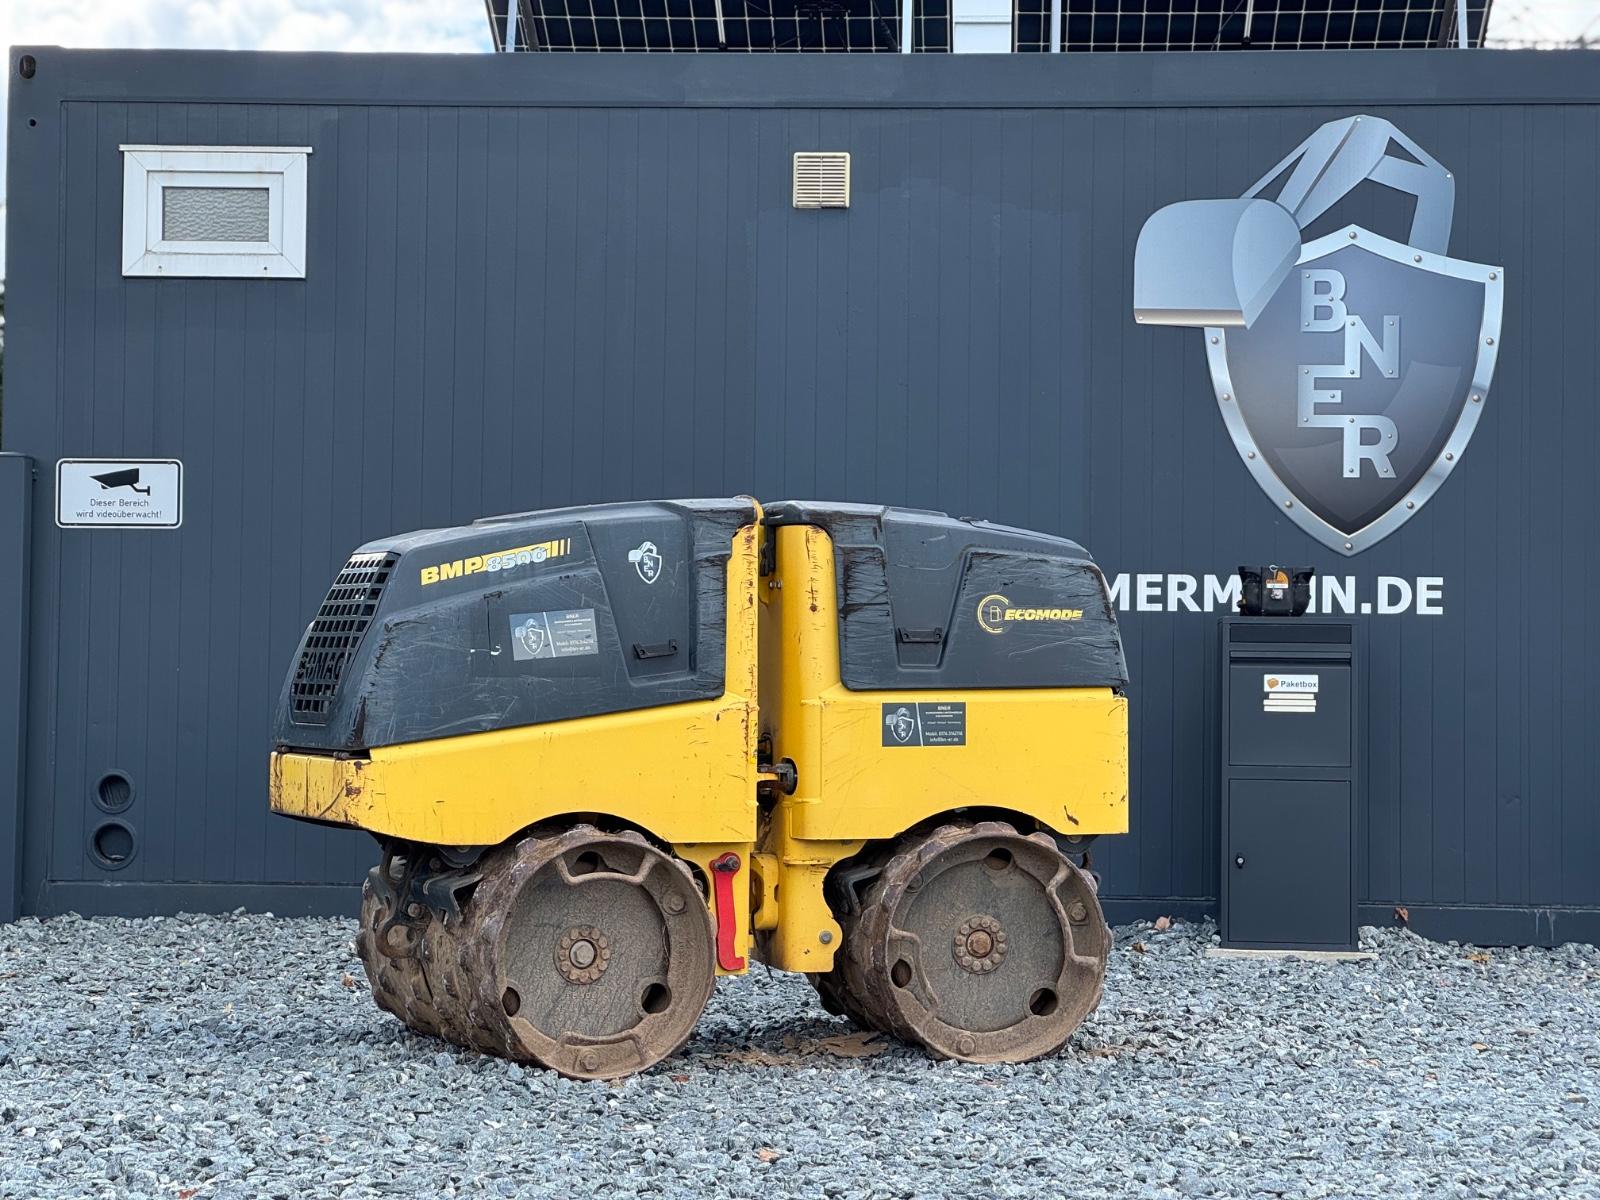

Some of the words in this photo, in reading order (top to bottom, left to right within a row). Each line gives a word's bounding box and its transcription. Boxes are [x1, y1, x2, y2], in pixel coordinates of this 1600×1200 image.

[90, 498, 116, 507] Dieser
[119, 498, 149, 507] Bereich
[76, 509, 94, 518] wird
[97, 509, 162, 519] videoüberwacht!
[420, 555, 484, 586] BMP
[486, 546, 548, 573] 8500
[1108, 573, 1444, 615] MERMN.DE
[1004, 609, 1083, 621] ECOMODE
[296, 651, 346, 681] BOMAG
[1280, 680, 1317, 688] Paketbox
